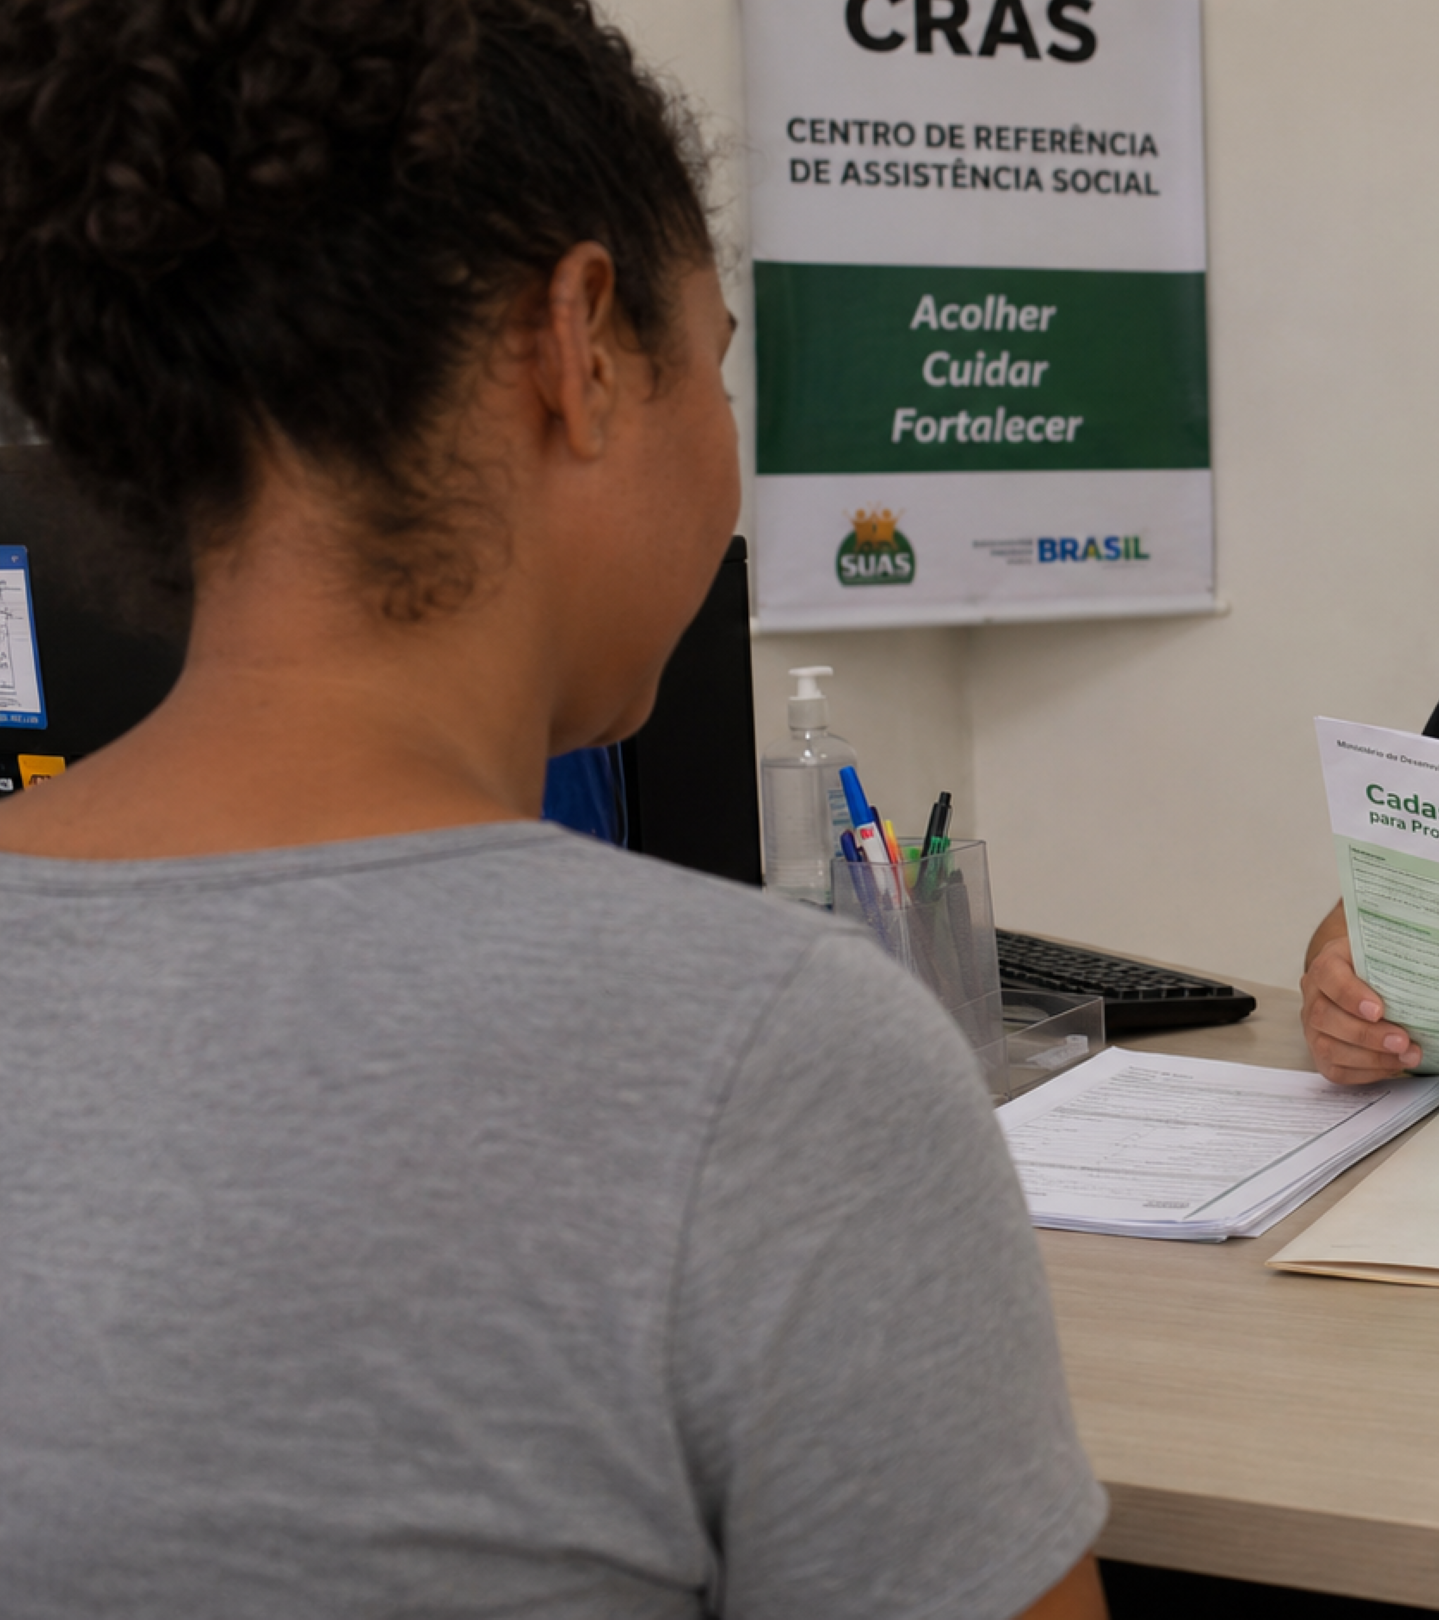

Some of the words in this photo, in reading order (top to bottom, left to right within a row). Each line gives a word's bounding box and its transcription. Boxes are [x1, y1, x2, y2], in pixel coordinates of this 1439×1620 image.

[845, 0, 1098, 63] CRAS
[787, 117, 915, 148] CENTRO
[925, 124, 966, 149] DE
[975, 123, 1158, 158] REFERÊNCIA
[790, 158, 830, 184] DE
[840, 158, 1043, 192] ASSISTÊNCIA
[1052, 169, 1160, 196] SOCIAL
[911, 293, 1056, 332] Acolher
[922, 351, 1048, 388] Cuidar
[892, 406, 1082, 443] Fortalecer
[841, 553, 911, 578] SUAS
[1038, 536, 1149, 563] BRASIL
[1370, 811, 1406, 830] para
